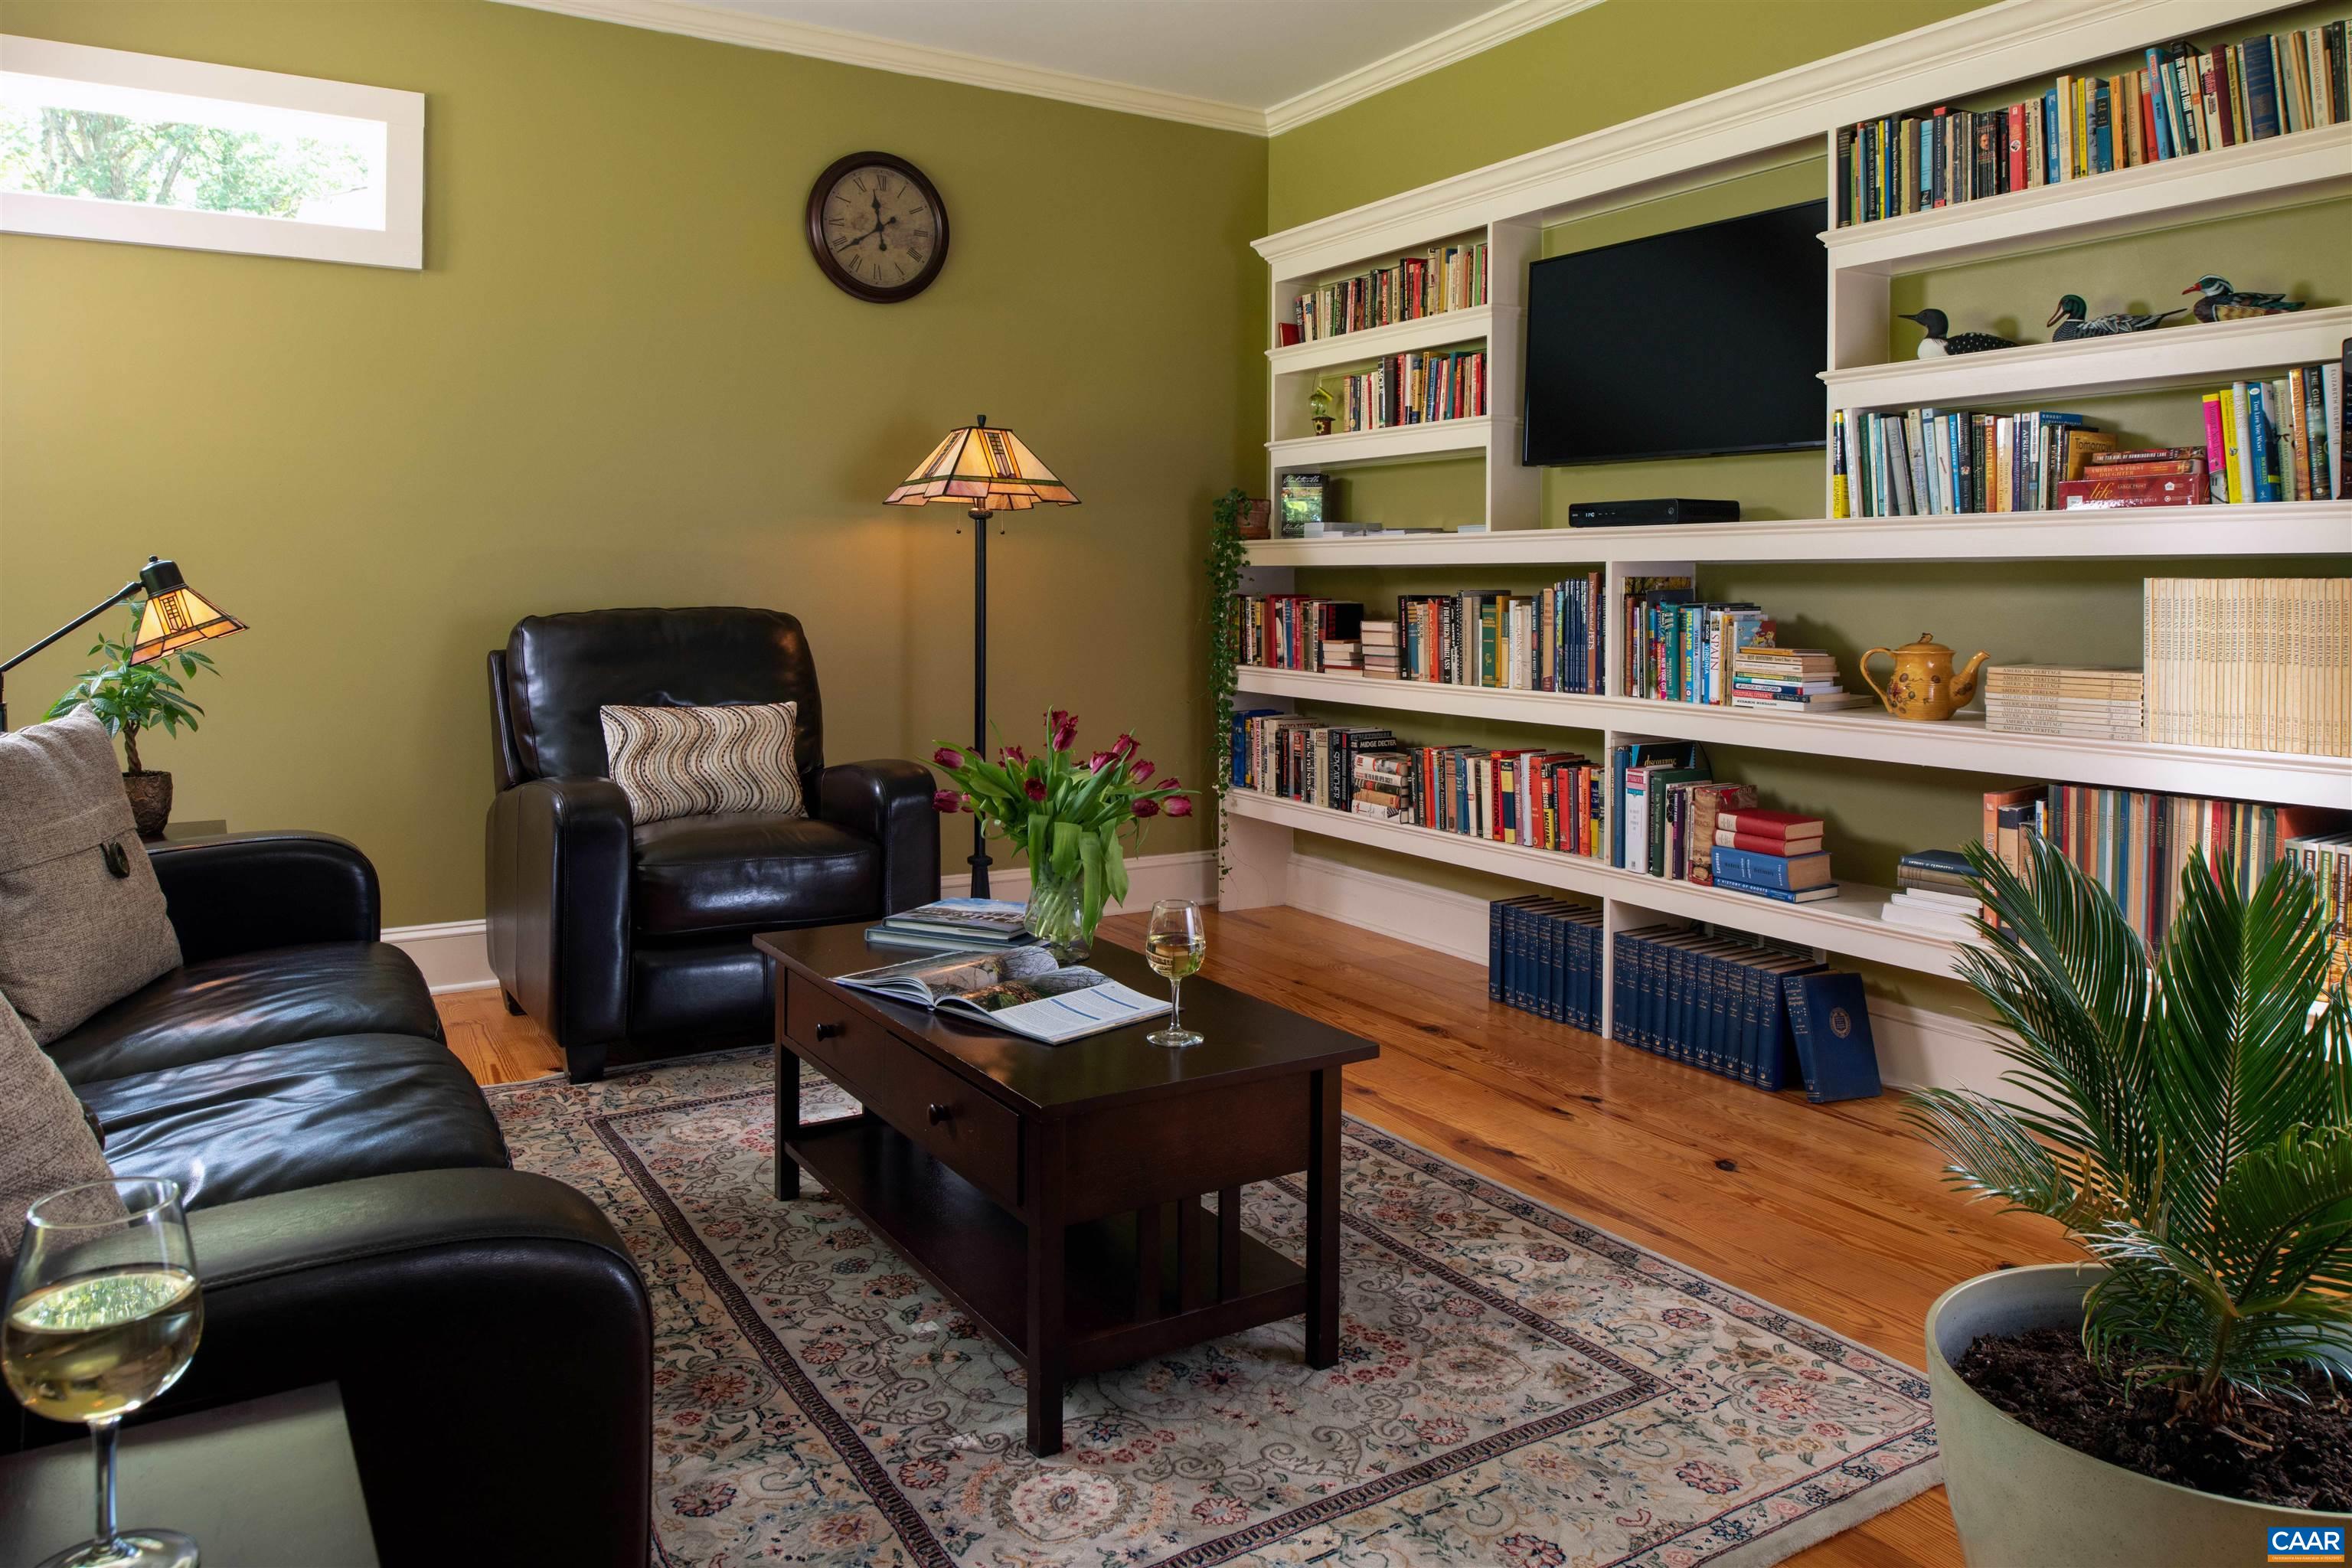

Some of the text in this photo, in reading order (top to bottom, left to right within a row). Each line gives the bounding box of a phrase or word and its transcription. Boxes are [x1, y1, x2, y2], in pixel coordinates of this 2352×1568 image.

[2295, 426, 2305, 461] ENERGY
[2090, 482, 2115, 499] life
[1710, 634, 1719, 671] SPAIN
